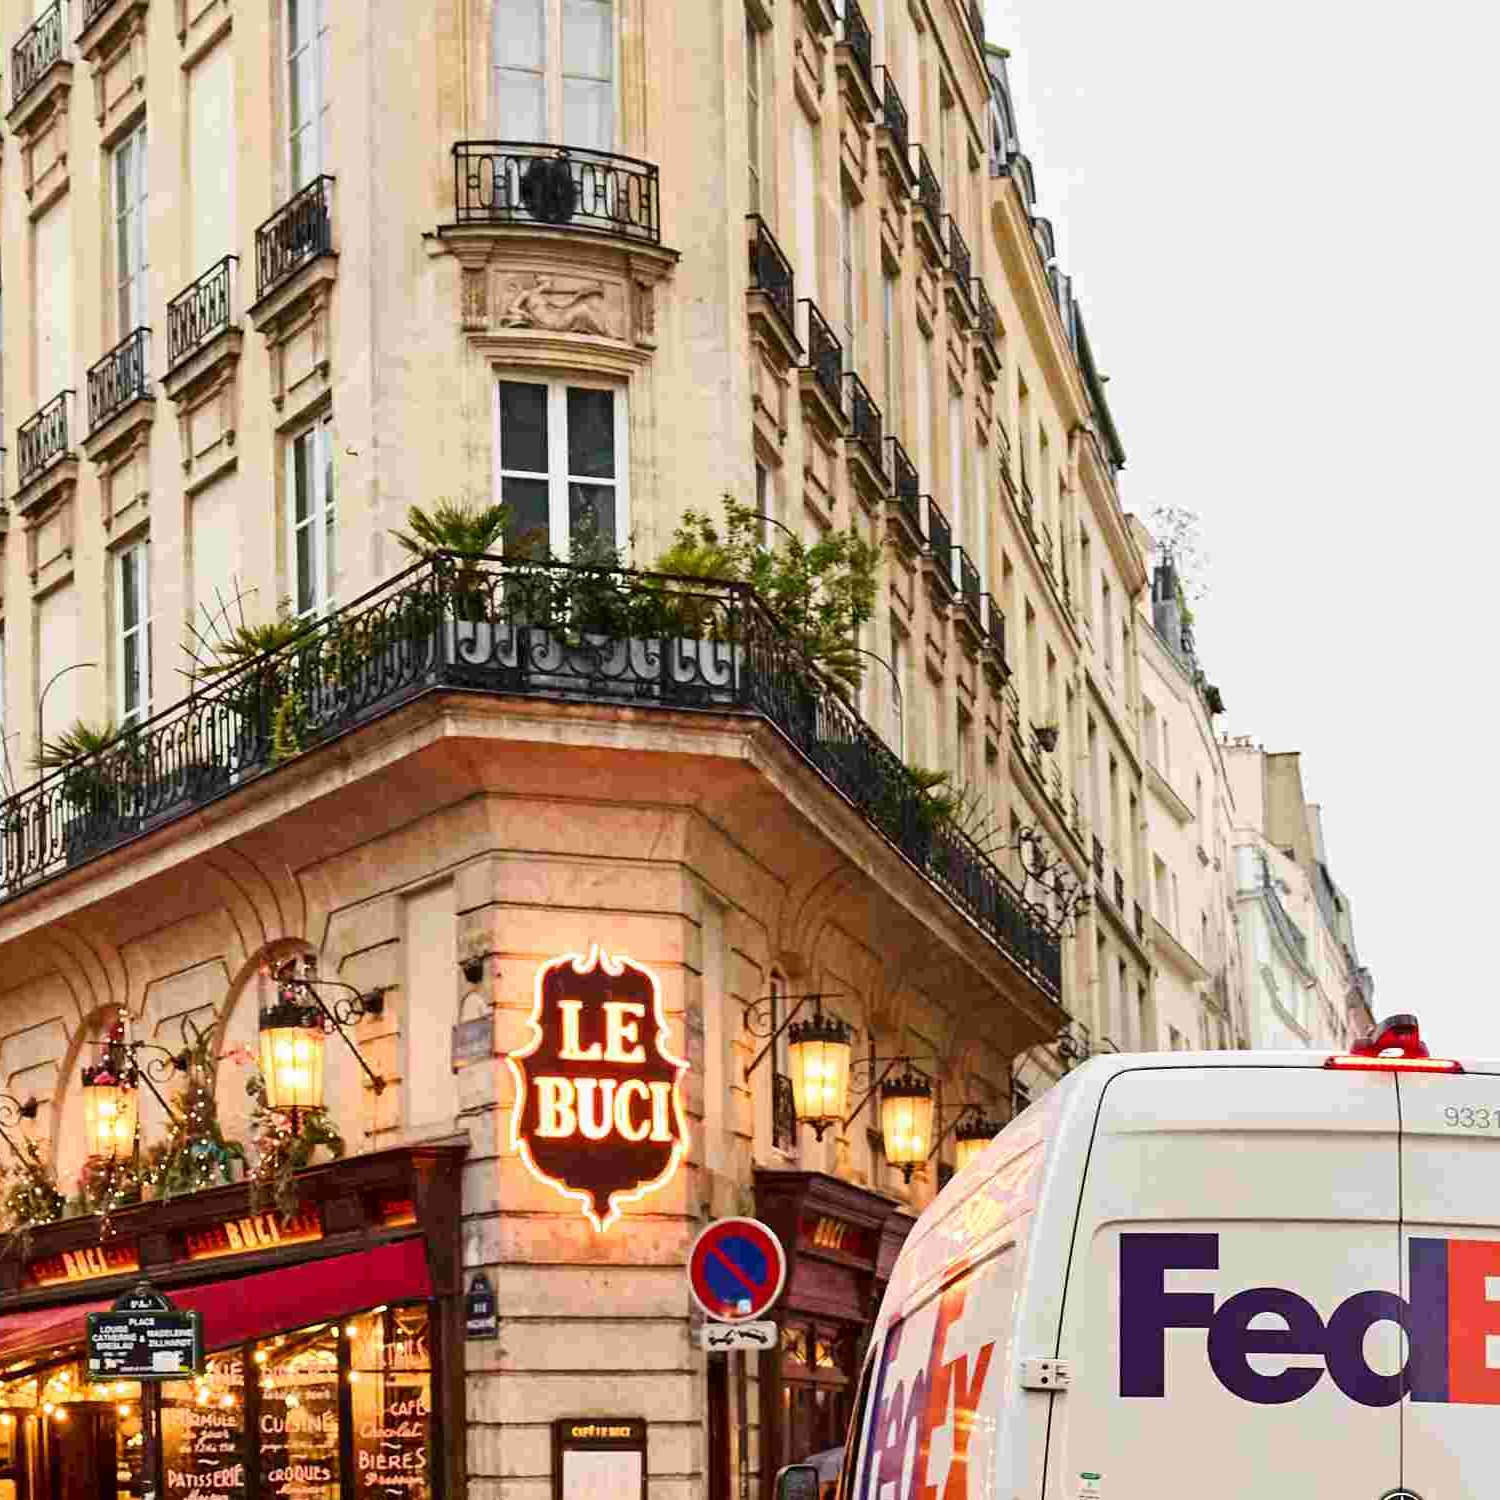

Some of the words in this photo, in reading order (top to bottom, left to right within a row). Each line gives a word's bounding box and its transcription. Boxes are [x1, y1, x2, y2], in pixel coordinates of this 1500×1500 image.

[557, 999, 646, 1064] LE
[532, 1074, 674, 1144] BUCI
[225, 1213, 281, 1250] BUCI
[128, 1317, 155, 1327] PLACE
[267, 1465, 332, 1483] CROQUES
